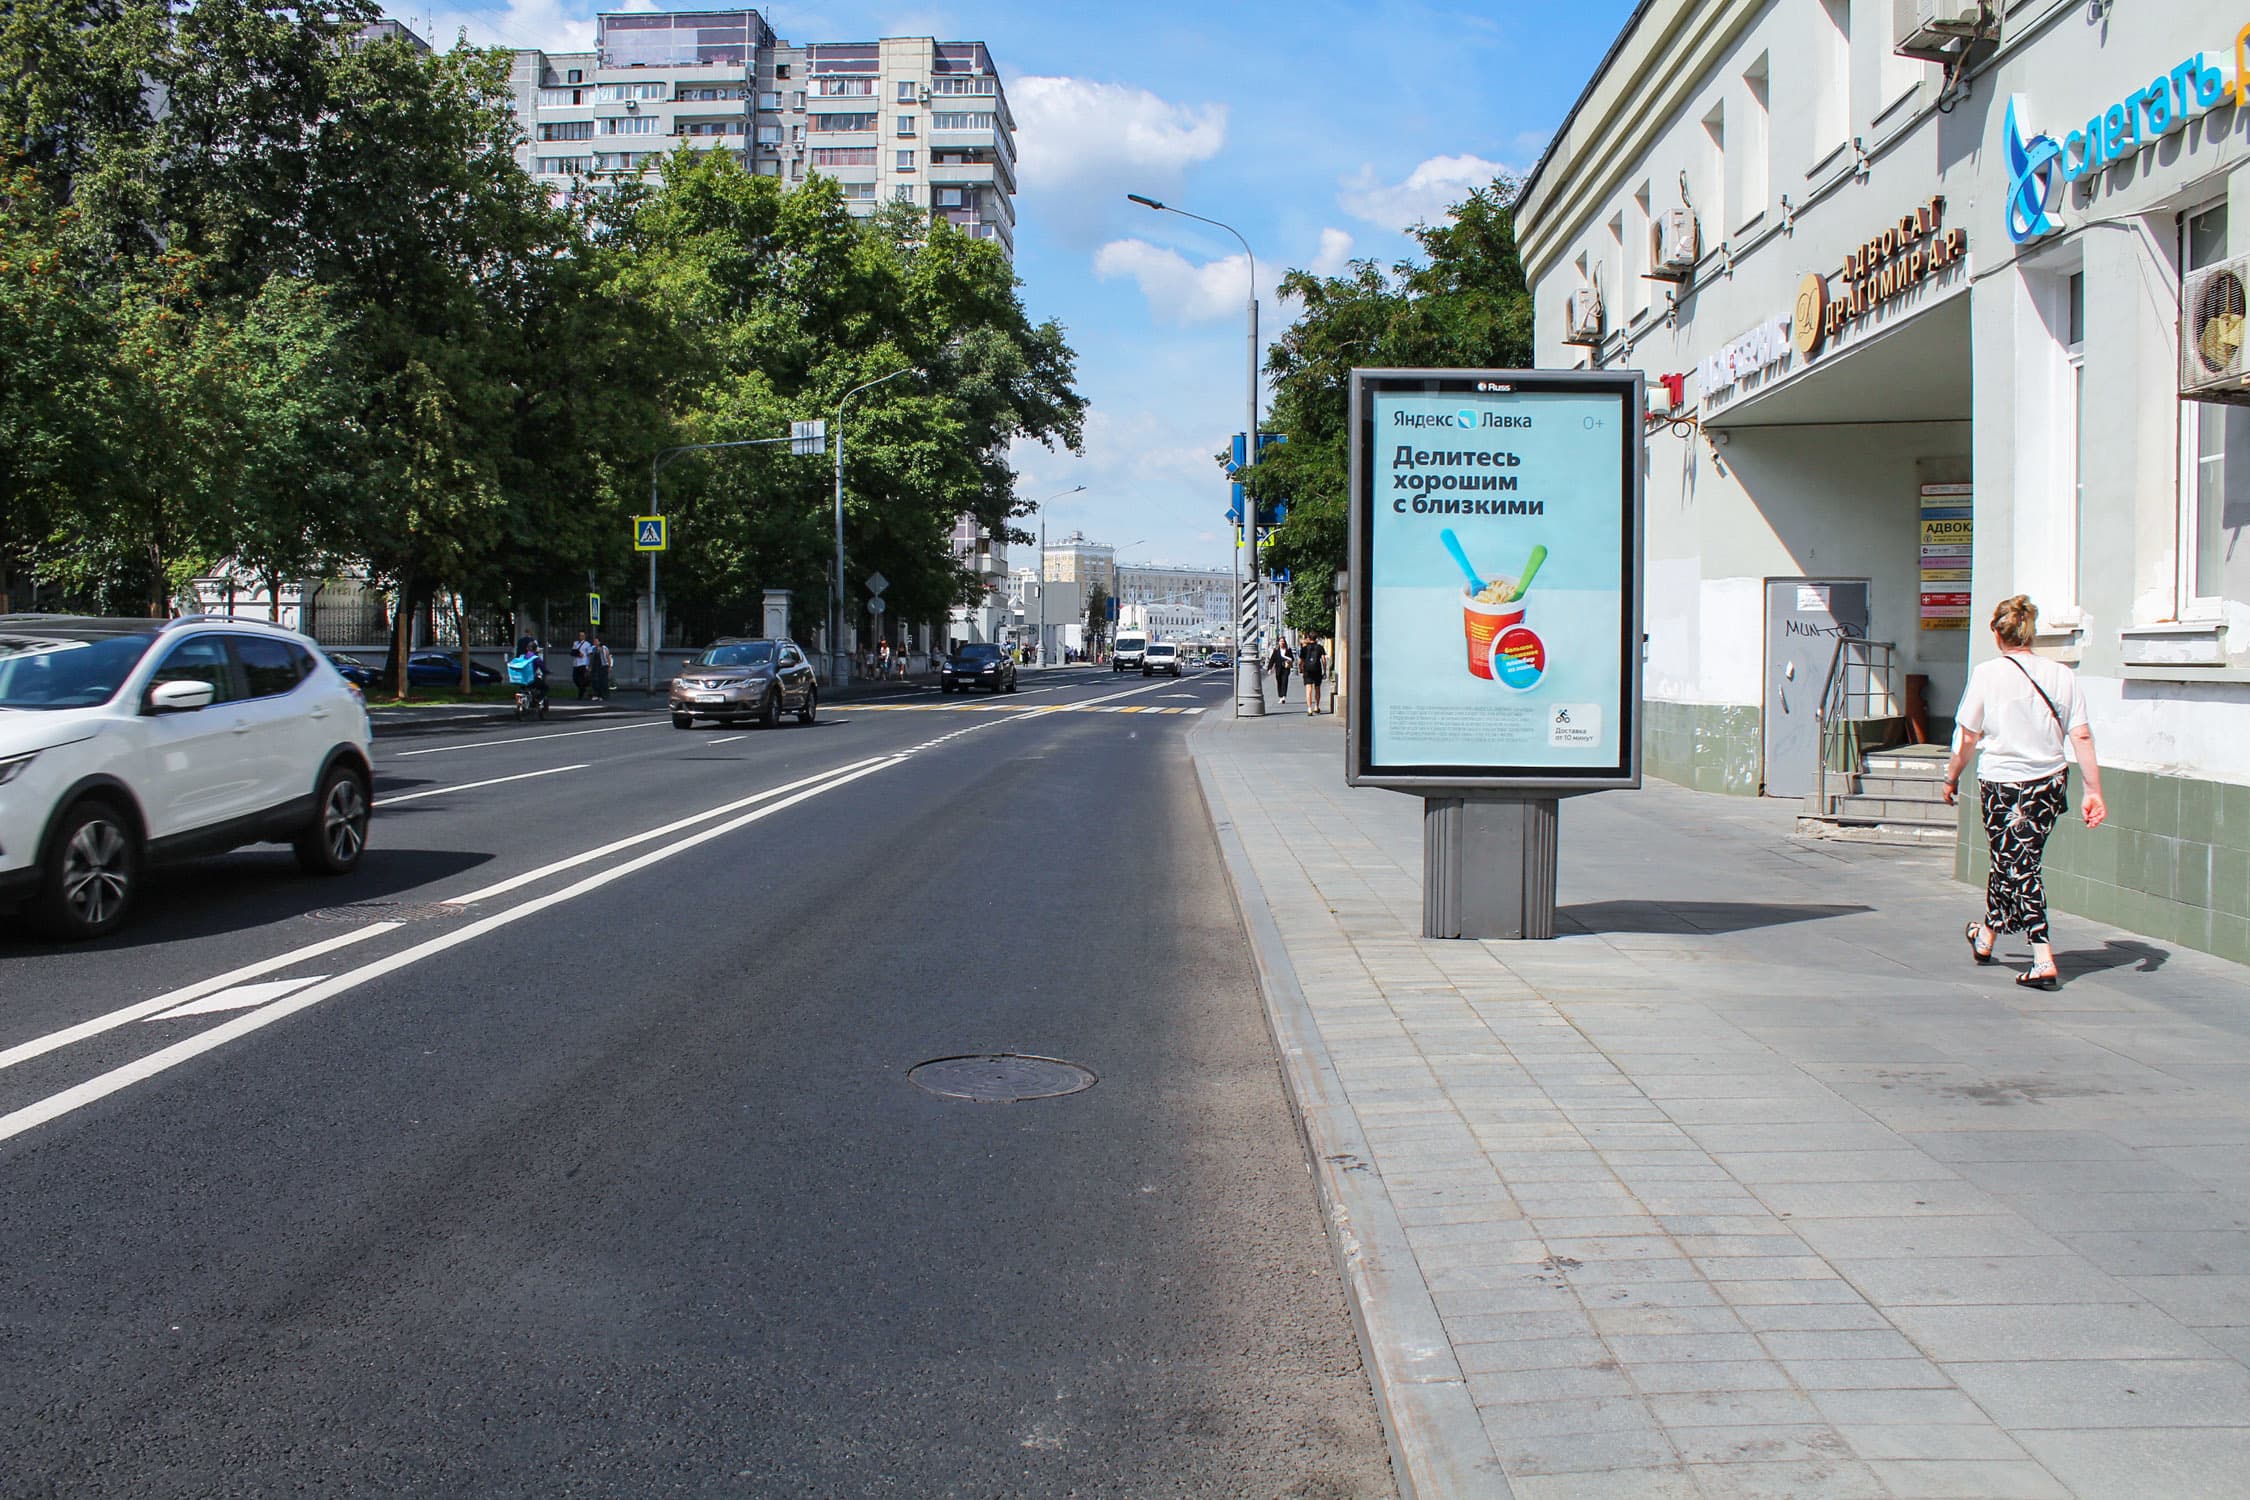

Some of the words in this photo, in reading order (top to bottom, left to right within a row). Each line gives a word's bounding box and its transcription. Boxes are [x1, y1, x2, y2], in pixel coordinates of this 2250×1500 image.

[1842, 195, 1945, 283] АДВОКАТ
[1825, 250, 1924, 336] ДРАГОМИР
[1393, 411, 1453, 428] Яндекс
[1481, 412, 1532, 428] Лавка
[1583, 416, 1605, 430] 0+
[1393, 446, 1521, 469] Делитесь
[1393, 474, 1518, 494] хорошим
[1393, 500, 1406, 513] с
[1412, 494, 1544, 515] близкими
[1926, 522, 1973, 534] АДВОК
[1572, 735, 1593, 743] минут
